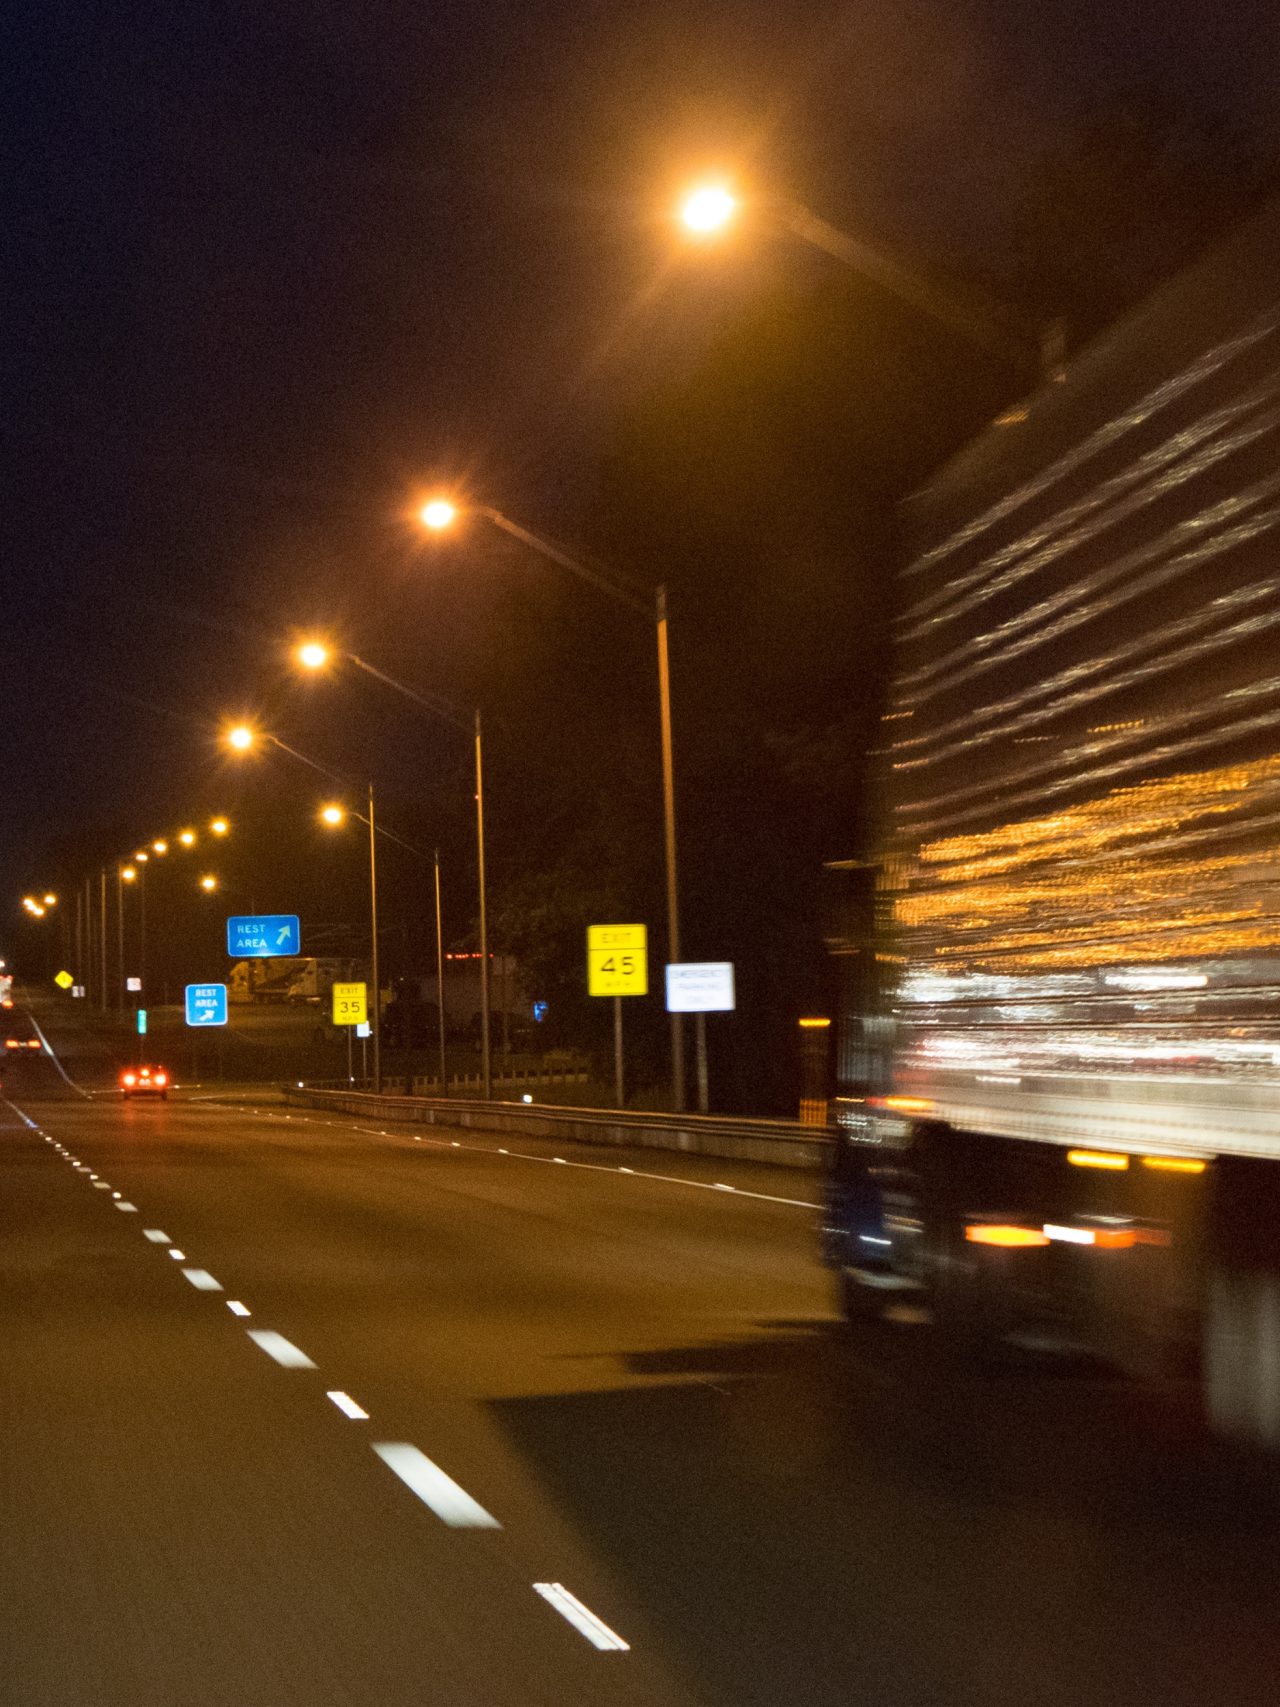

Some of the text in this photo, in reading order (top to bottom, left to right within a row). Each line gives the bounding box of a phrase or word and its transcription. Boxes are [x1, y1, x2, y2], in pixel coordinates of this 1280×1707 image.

[237, 924, 266, 934] REST
[236, 938, 268, 949] AREA
[600, 955, 636, 976] 45
[194, 988, 217, 997] REST
[340, 986, 358, 995] EXIT
[194, 999, 218, 1008] AREA
[339, 1001, 361, 1014] 35
